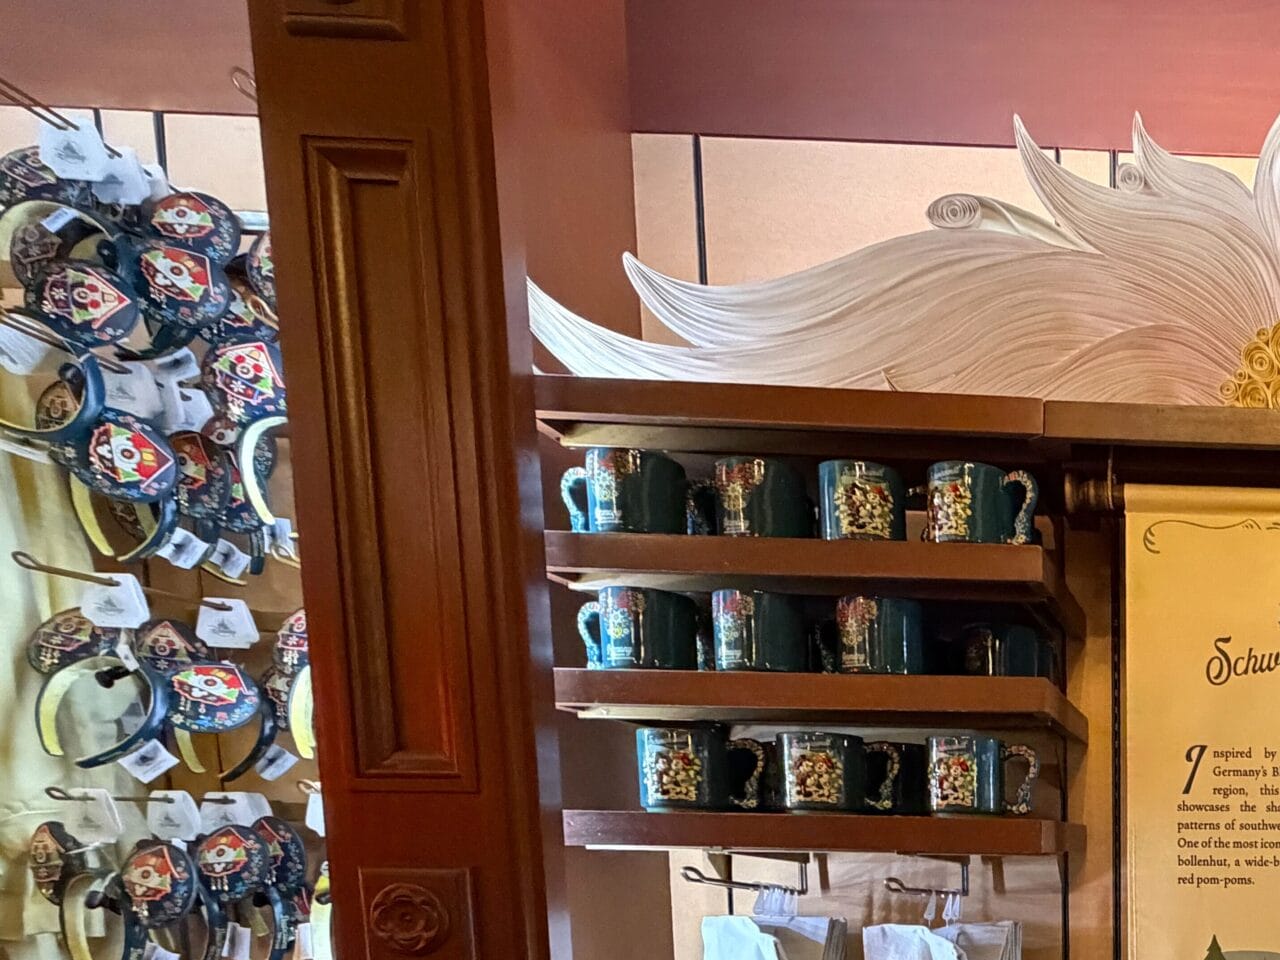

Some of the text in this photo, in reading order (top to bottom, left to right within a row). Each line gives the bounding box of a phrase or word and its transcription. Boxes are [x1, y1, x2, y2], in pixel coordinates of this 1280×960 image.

[1264, 748, 1277, 762] by
[1213, 766, 1267, 780] Germany's
[1213, 786, 1248, 798] region,
[1260, 785, 1279, 795] this
[1177, 801, 1230, 812] showcases
[1240, 802, 1256, 812] the
[1177, 820, 1220, 833] patterns
[1225, 820, 1237, 830] of
[1177, 838, 1199, 848] One
[1201, 838, 1214, 848] of
[1214, 838, 1231, 848] the
[1232, 840, 1258, 849] most
[1177, 855, 1231, 868] bollenhut,
[1234, 859, 1240, 867] a
[1177, 874, 1255, 888] red pom-poms.
